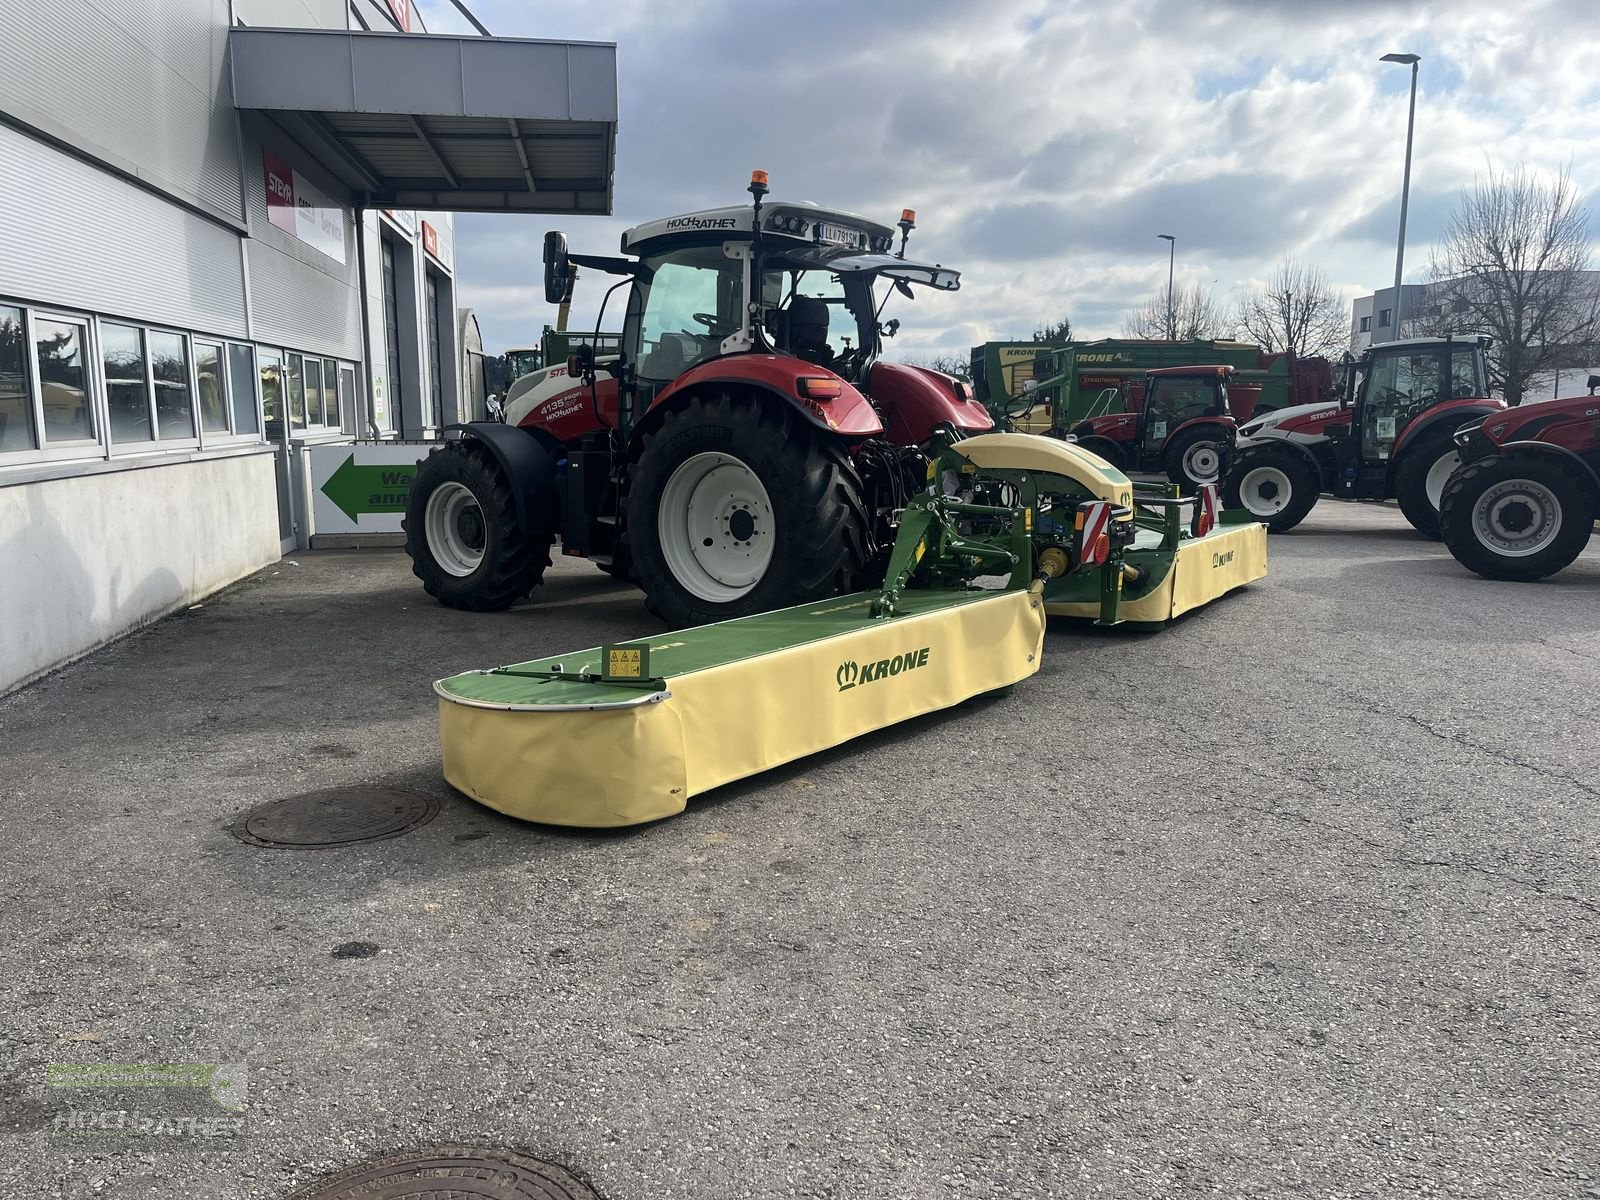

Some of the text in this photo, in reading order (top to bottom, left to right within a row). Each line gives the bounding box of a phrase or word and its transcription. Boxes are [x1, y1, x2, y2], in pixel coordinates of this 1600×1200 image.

[268, 171, 293, 204] STEYR
[666, 216, 737, 229] HOCHRATHER
[1007, 349, 1037, 357] KRON
[541, 391, 582, 416] 4135 PROFI
[546, 403, 583, 422] HOCHRATHER
[1310, 410, 1337, 421] STEYR
[858, 647, 930, 686] KRONE
